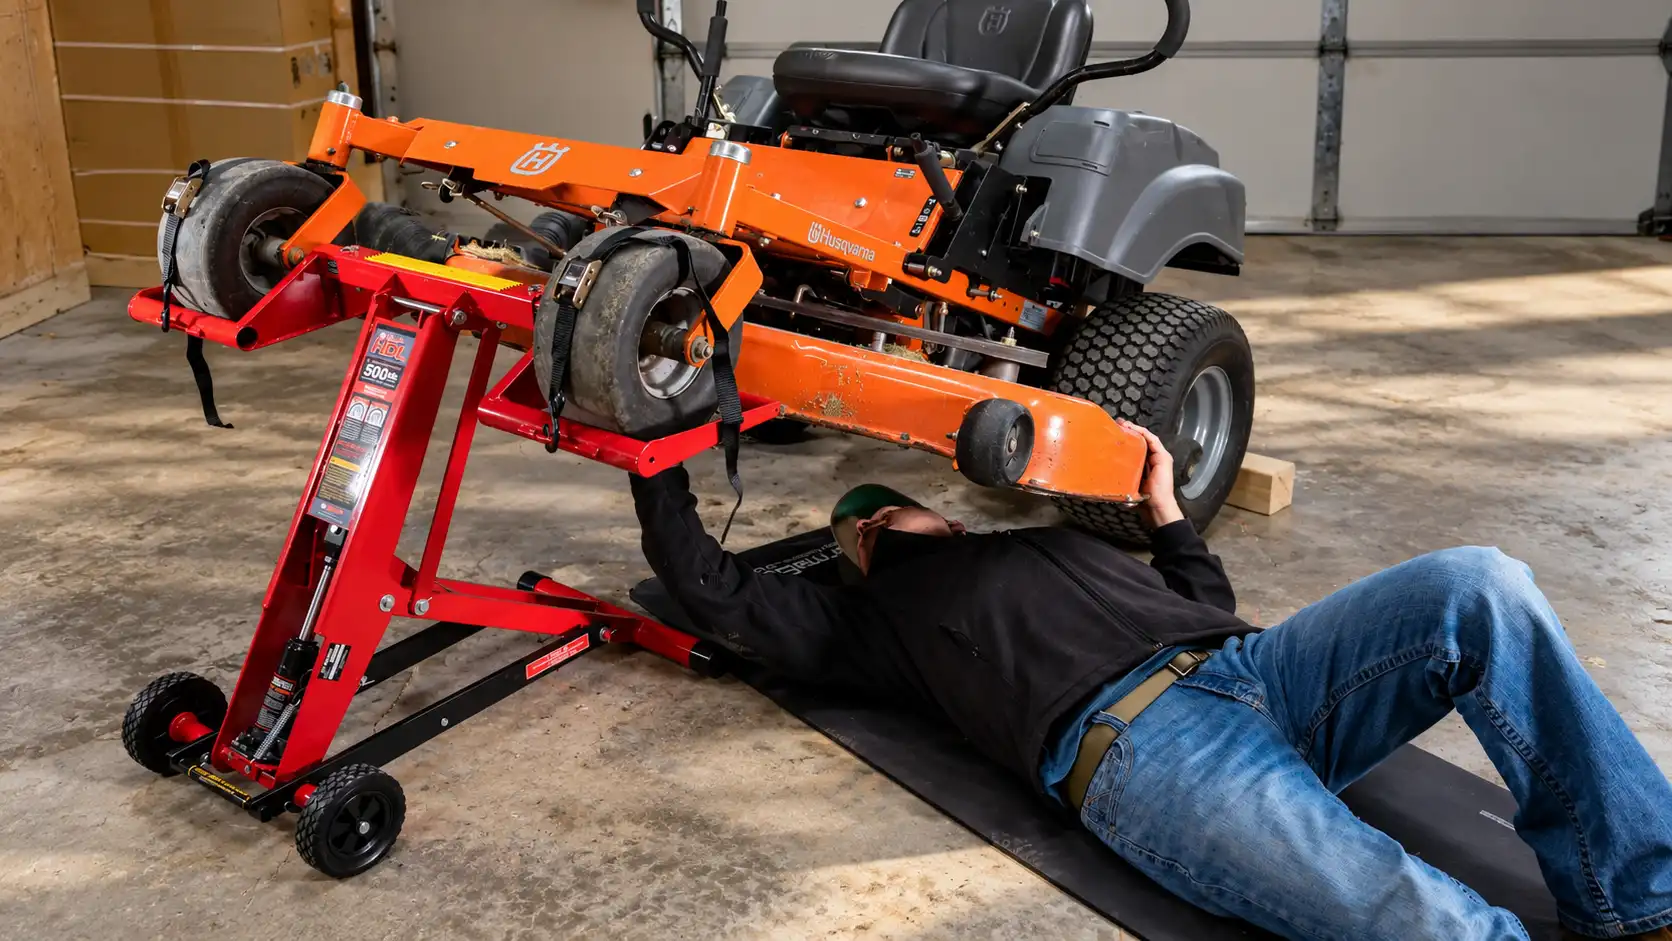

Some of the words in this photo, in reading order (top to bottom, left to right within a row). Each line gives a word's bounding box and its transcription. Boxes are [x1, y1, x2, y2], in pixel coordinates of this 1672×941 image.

[820, 227, 876, 262] Husqvarna
[371, 336, 406, 362] HDL
[363, 363, 389, 381] 500
